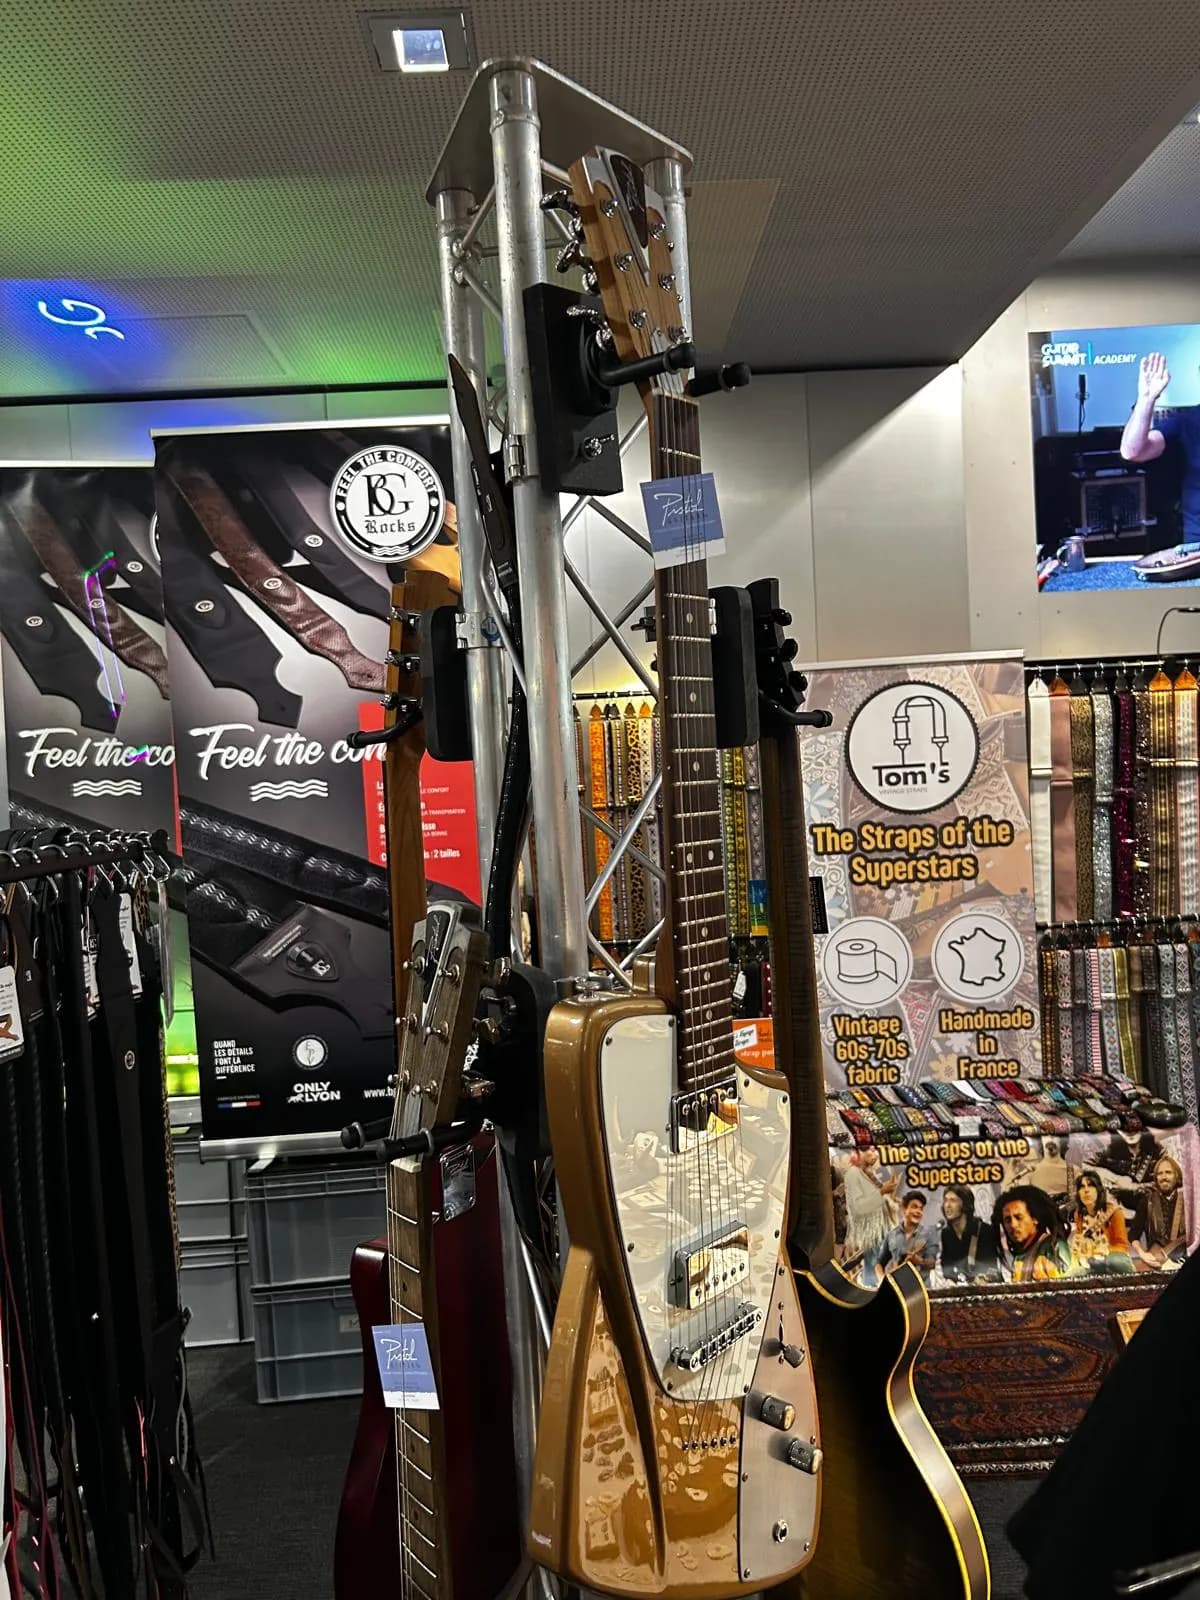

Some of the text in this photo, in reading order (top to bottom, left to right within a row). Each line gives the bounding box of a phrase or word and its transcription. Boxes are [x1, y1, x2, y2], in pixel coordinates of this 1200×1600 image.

[1093, 353, 1137, 365] ACADEMY
[337, 451, 438, 497] FEEL THE COMFORT
[364, 518, 416, 534] Rocks
[18, 727, 92, 778] Feel
[93, 737, 137, 767] the
[188, 723, 271, 781] Feel
[273, 732, 324, 766] the
[872, 761, 951, 787] Tom's
[811, 816, 1012, 854] The Straps of the
[439, 847, 460, 858] tailles
[850, 854, 977, 887] Superstars
[832, 1014, 901, 1038] Vintage
[939, 1007, 1034, 1032] Handmade
[213, 1040, 236, 1049] QUAND
[214, 1046, 254, 1057] LES DÉTAILS
[834, 1037, 910, 1062] 60s-70s
[978, 1033, 997, 1055] in
[215, 1056, 242, 1066] FONT LA
[215, 1063, 256, 1075] DIFFÉRENCE
[958, 1058, 1021, 1080] France
[847, 1063, 900, 1086] fabric
[293, 1081, 331, 1093] ONLY
[304, 1090, 341, 1102] LYON
[878, 1137, 1029, 1165] The Straps of the
[907, 1163, 1002, 1190] Superstars
